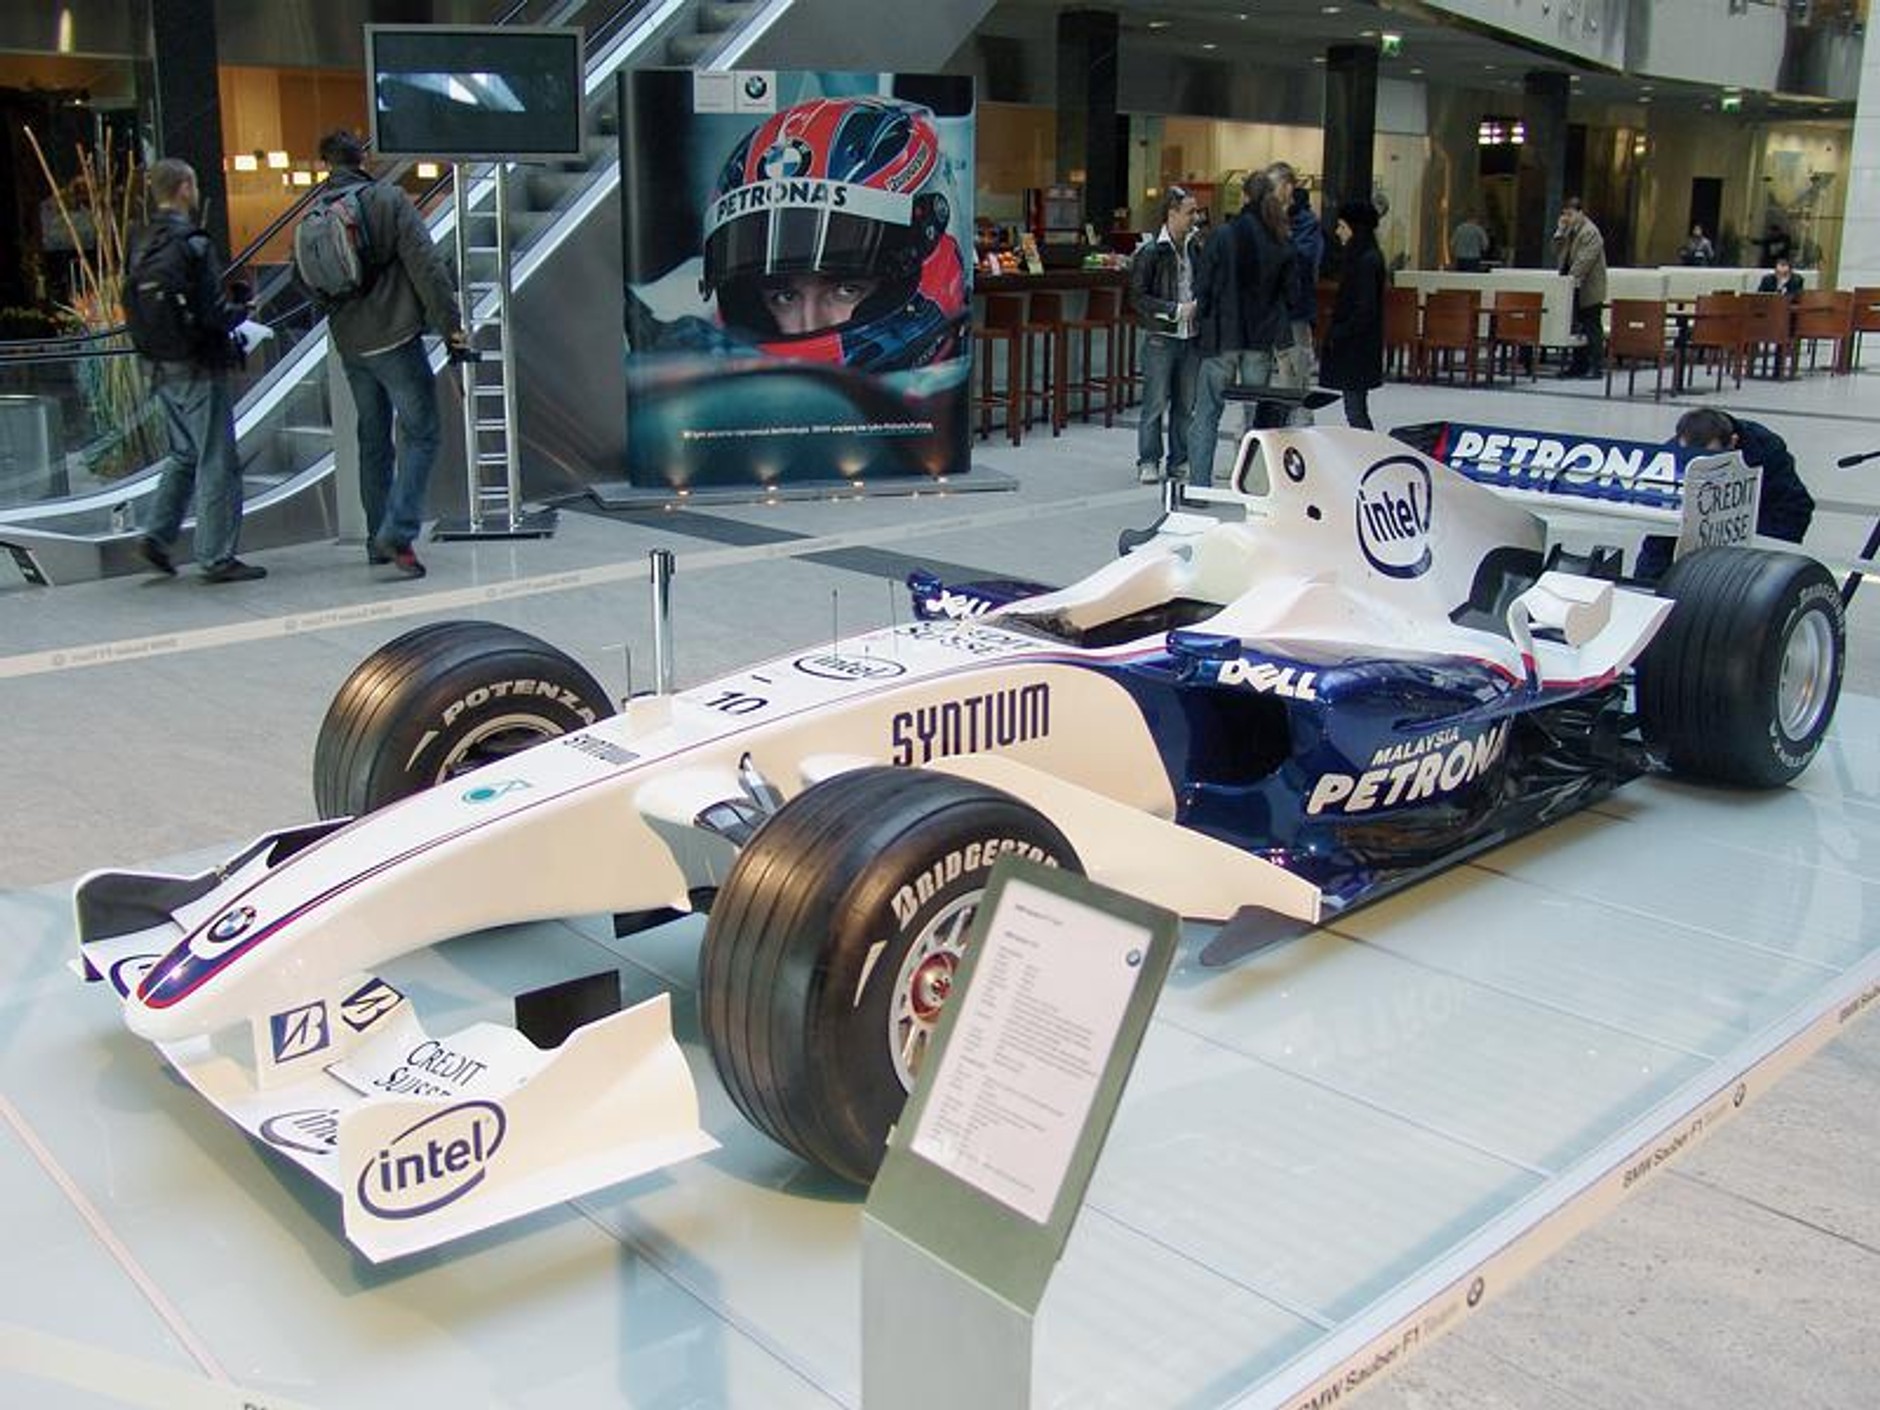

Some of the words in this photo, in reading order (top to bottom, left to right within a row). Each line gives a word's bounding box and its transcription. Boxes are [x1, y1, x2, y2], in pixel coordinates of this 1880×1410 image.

[716, 181, 847, 222] PETRONAS
[1450, 431, 1685, 494] PETRONA
[1358, 481, 1423, 544] intel
[1697, 477, 1757, 515] CREDIT
[442, 679, 597, 728] POTENZA
[705, 690, 770, 715] 10
[1217, 658, 1317, 700] DELL
[893, 681, 1050, 767] SYNTIUM
[1372, 726, 1460, 766] MALAYSIA
[1306, 716, 1512, 814] PETRONA
[406, 1040, 488, 1087] CREDIT
[379, 1119, 483, 1193] intel
[1345, 1344, 1400, 1393] Sauber
[1401, 1327, 1420, 1352] F1
